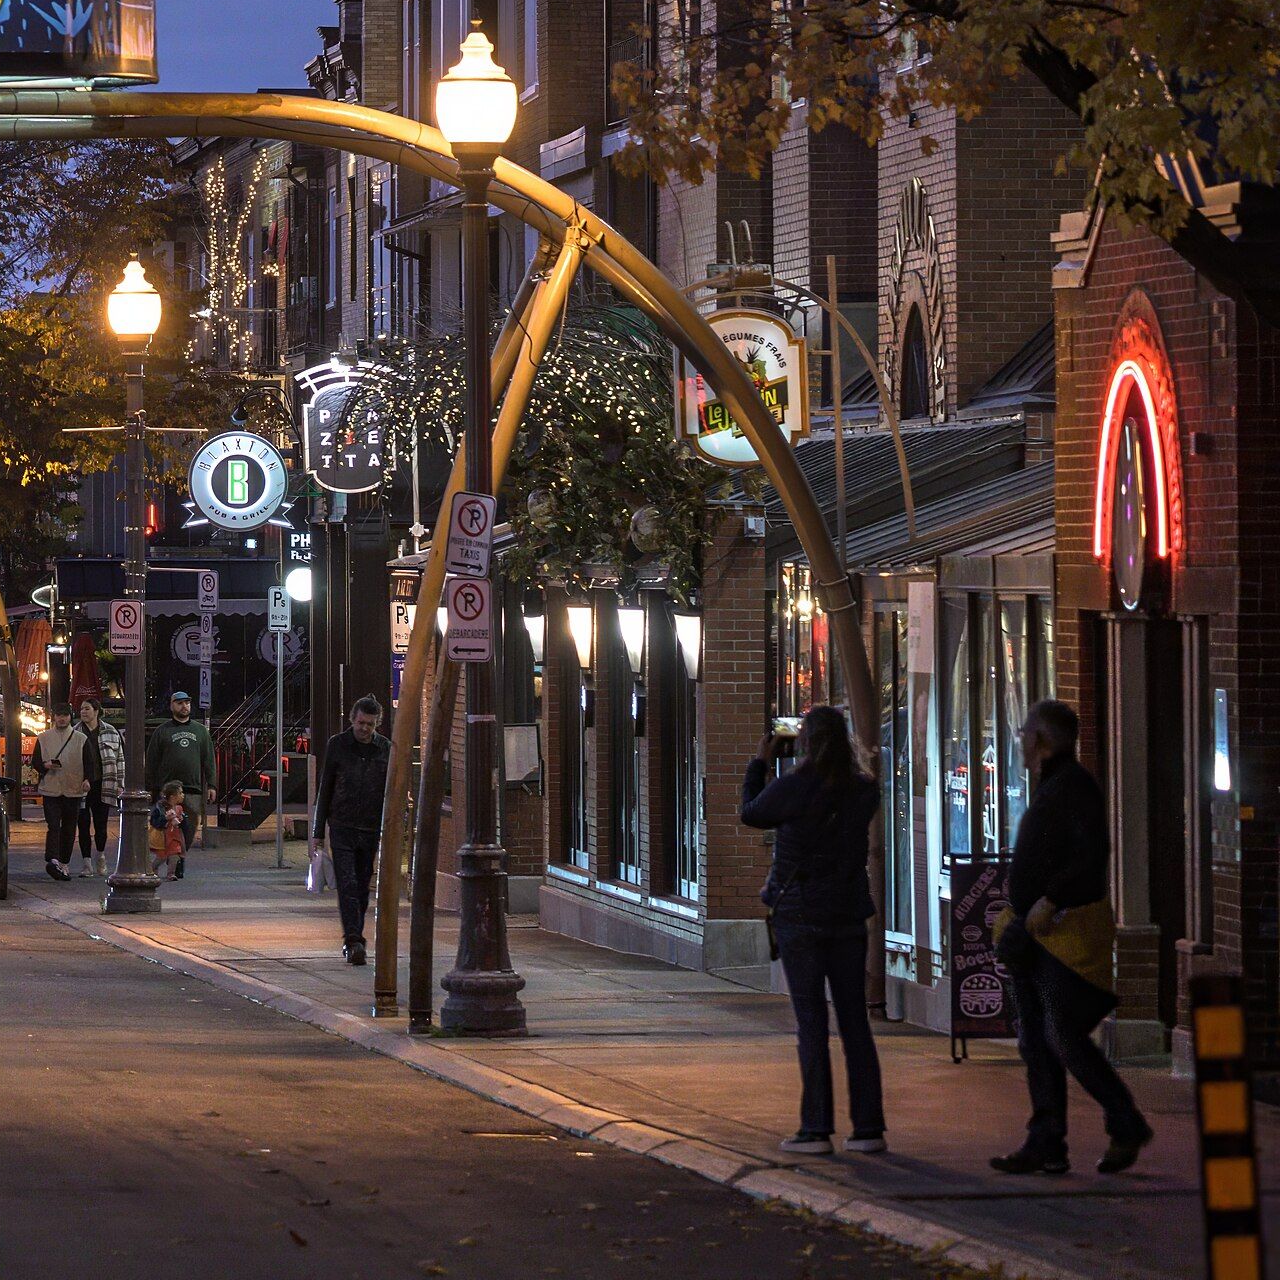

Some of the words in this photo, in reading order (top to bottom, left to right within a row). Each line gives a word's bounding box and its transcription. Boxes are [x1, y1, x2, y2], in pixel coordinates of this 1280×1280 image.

[723, 331, 765, 345] ÉGUMES
[765, 342, 786, 369] FRAIS
[198, 437, 278, 472] BLAXTON
[228, 460, 249, 505] B
[209, 504, 228, 519] PUB
[242, 505, 269, 521] GRILL
[459, 548, 480, 561] TAXIS
